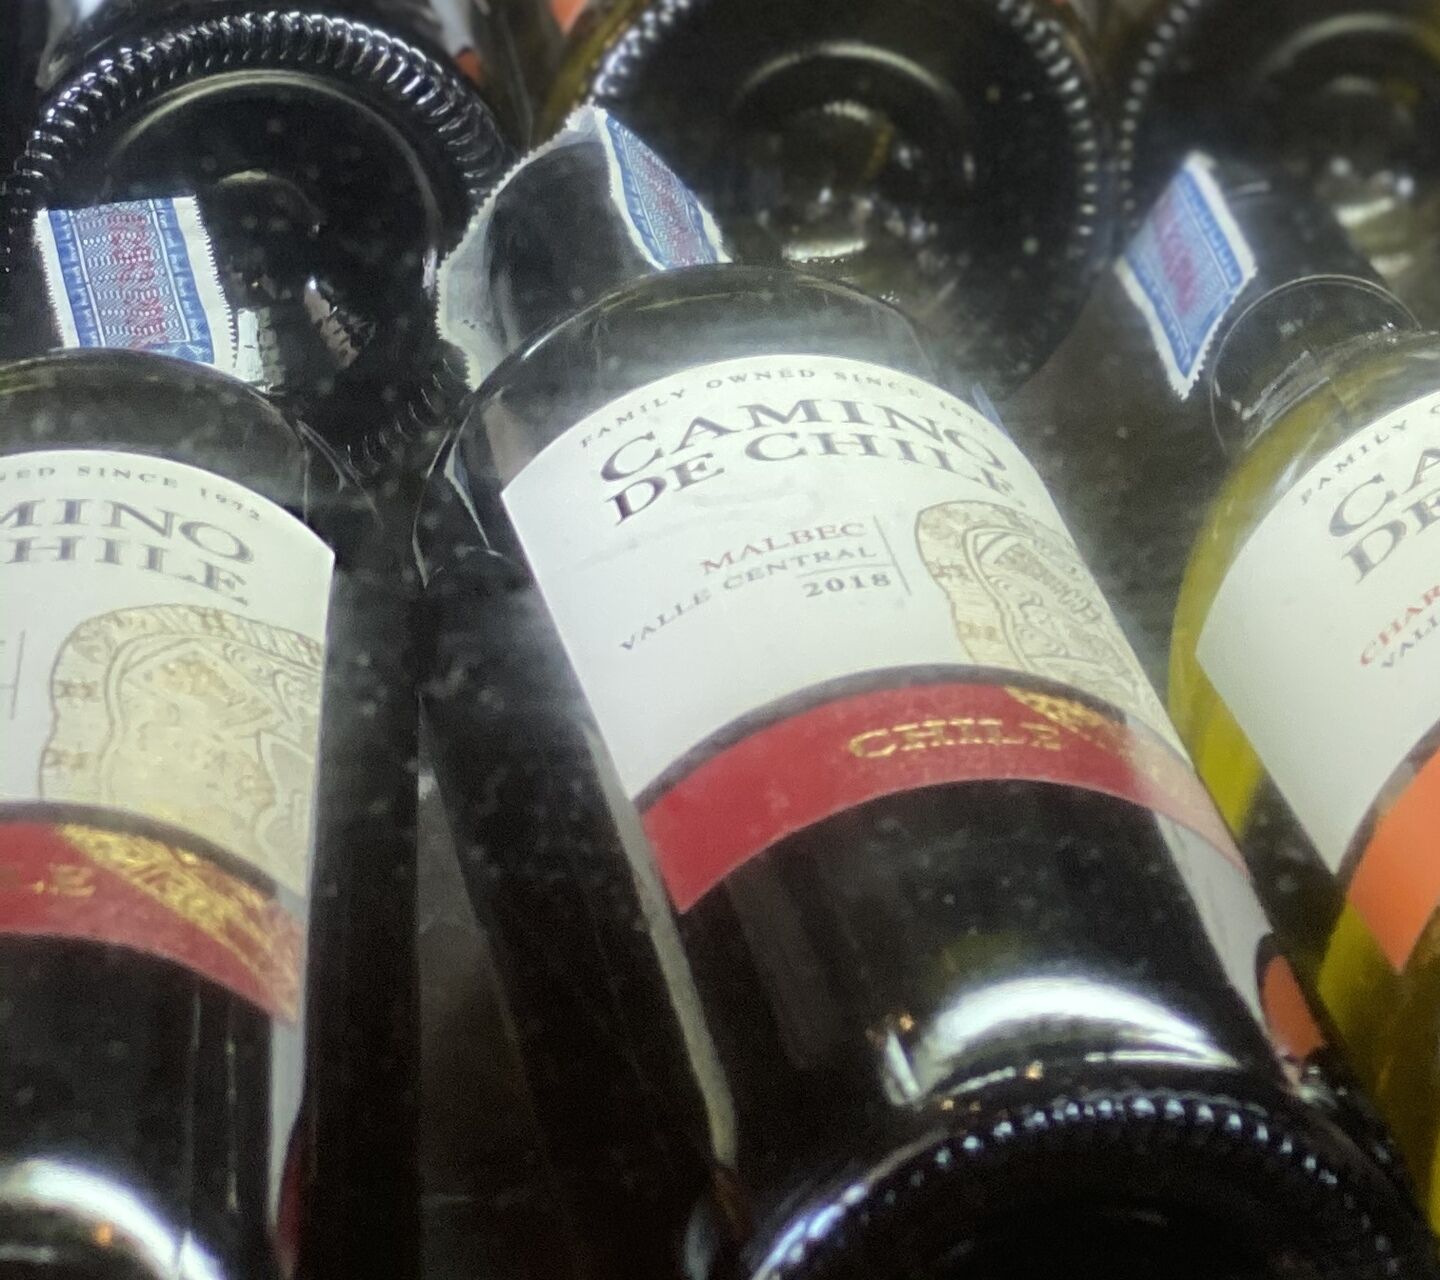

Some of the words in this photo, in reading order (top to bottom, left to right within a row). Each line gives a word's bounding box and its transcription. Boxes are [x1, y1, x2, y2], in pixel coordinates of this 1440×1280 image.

[580, 387, 687, 449] FAMILY
[705, 368, 816, 390] OWNED
[833, 370, 922, 399] SINCE
[600, 398, 1007, 483] CAMINO
[76, 466, 179, 488] SINCE
[603, 452, 726, 527] DE
[744, 431, 1028, 509] CHILE
[1301, 418, 1409, 507] FAMILY
[699, 521, 866, 576] MALBEC
[801, 572, 892, 599] 2018
[619, 587, 713, 651] VALLE
[721, 546, 878, 591] CENTRAL
[848, 717, 1062, 758] CHILE
